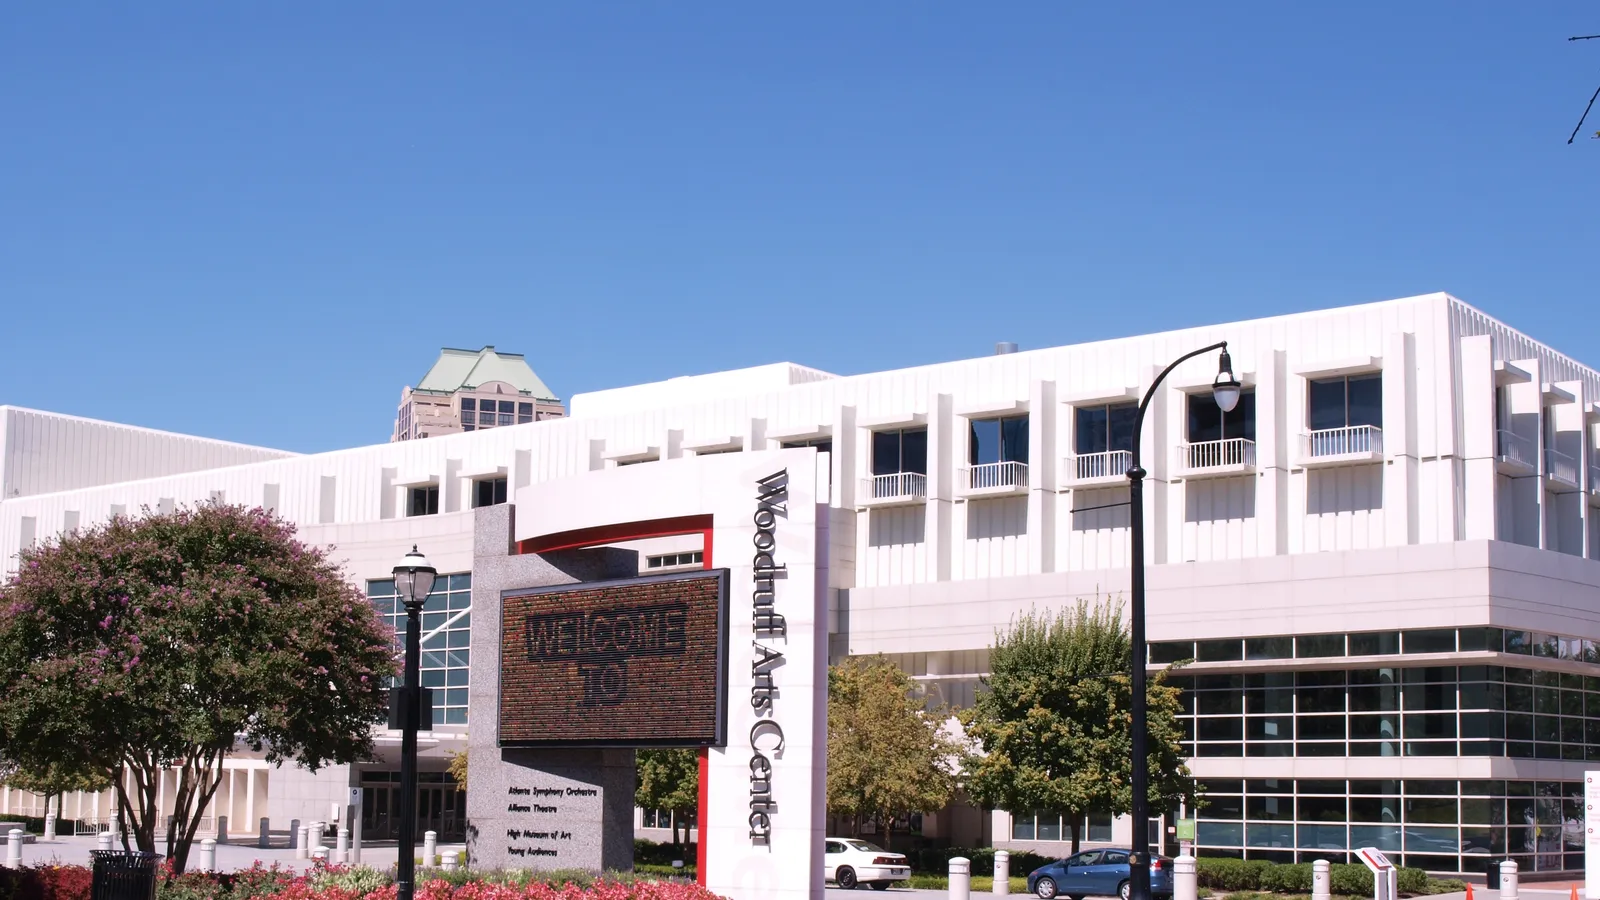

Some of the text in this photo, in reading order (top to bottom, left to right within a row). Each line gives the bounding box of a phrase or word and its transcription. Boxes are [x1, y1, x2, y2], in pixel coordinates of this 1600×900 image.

[526, 607, 686, 658] WELCOME
[749, 467, 787, 842] Woodruff Arts Center
[578, 661, 625, 701] TO
[508, 786, 597, 798] Atlanta Symphony Orchestra
[508, 803, 557, 813] Alliance Theatre
[507, 829, 571, 841] High Museum of Art
[507, 846, 558, 857] Young Audiences
